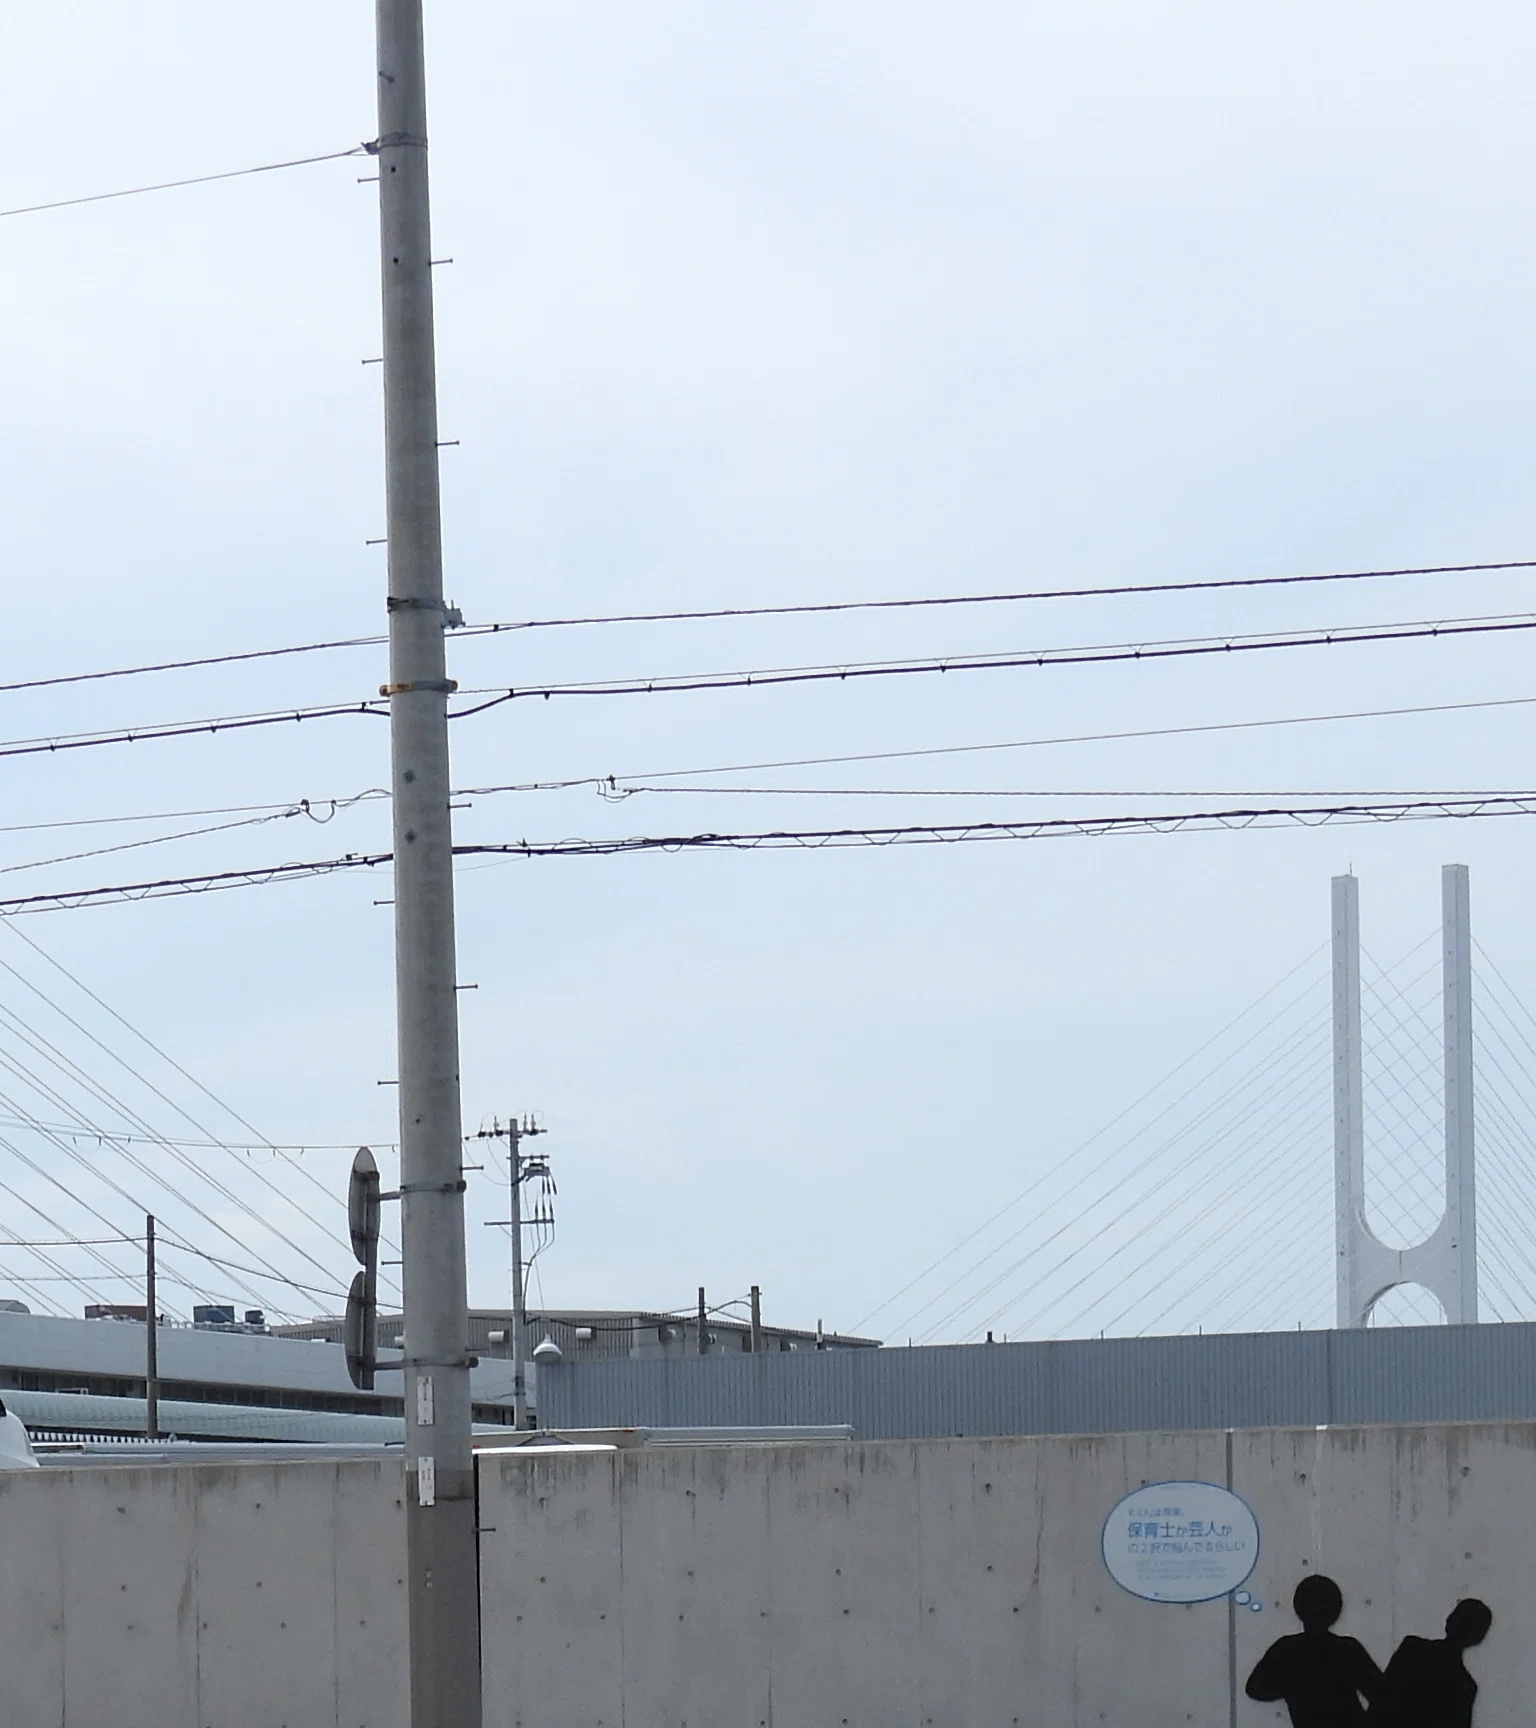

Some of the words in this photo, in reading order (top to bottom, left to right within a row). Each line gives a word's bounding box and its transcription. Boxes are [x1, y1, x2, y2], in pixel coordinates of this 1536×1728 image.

[1128, 1521, 1232, 1539] 保育士か芸人か
